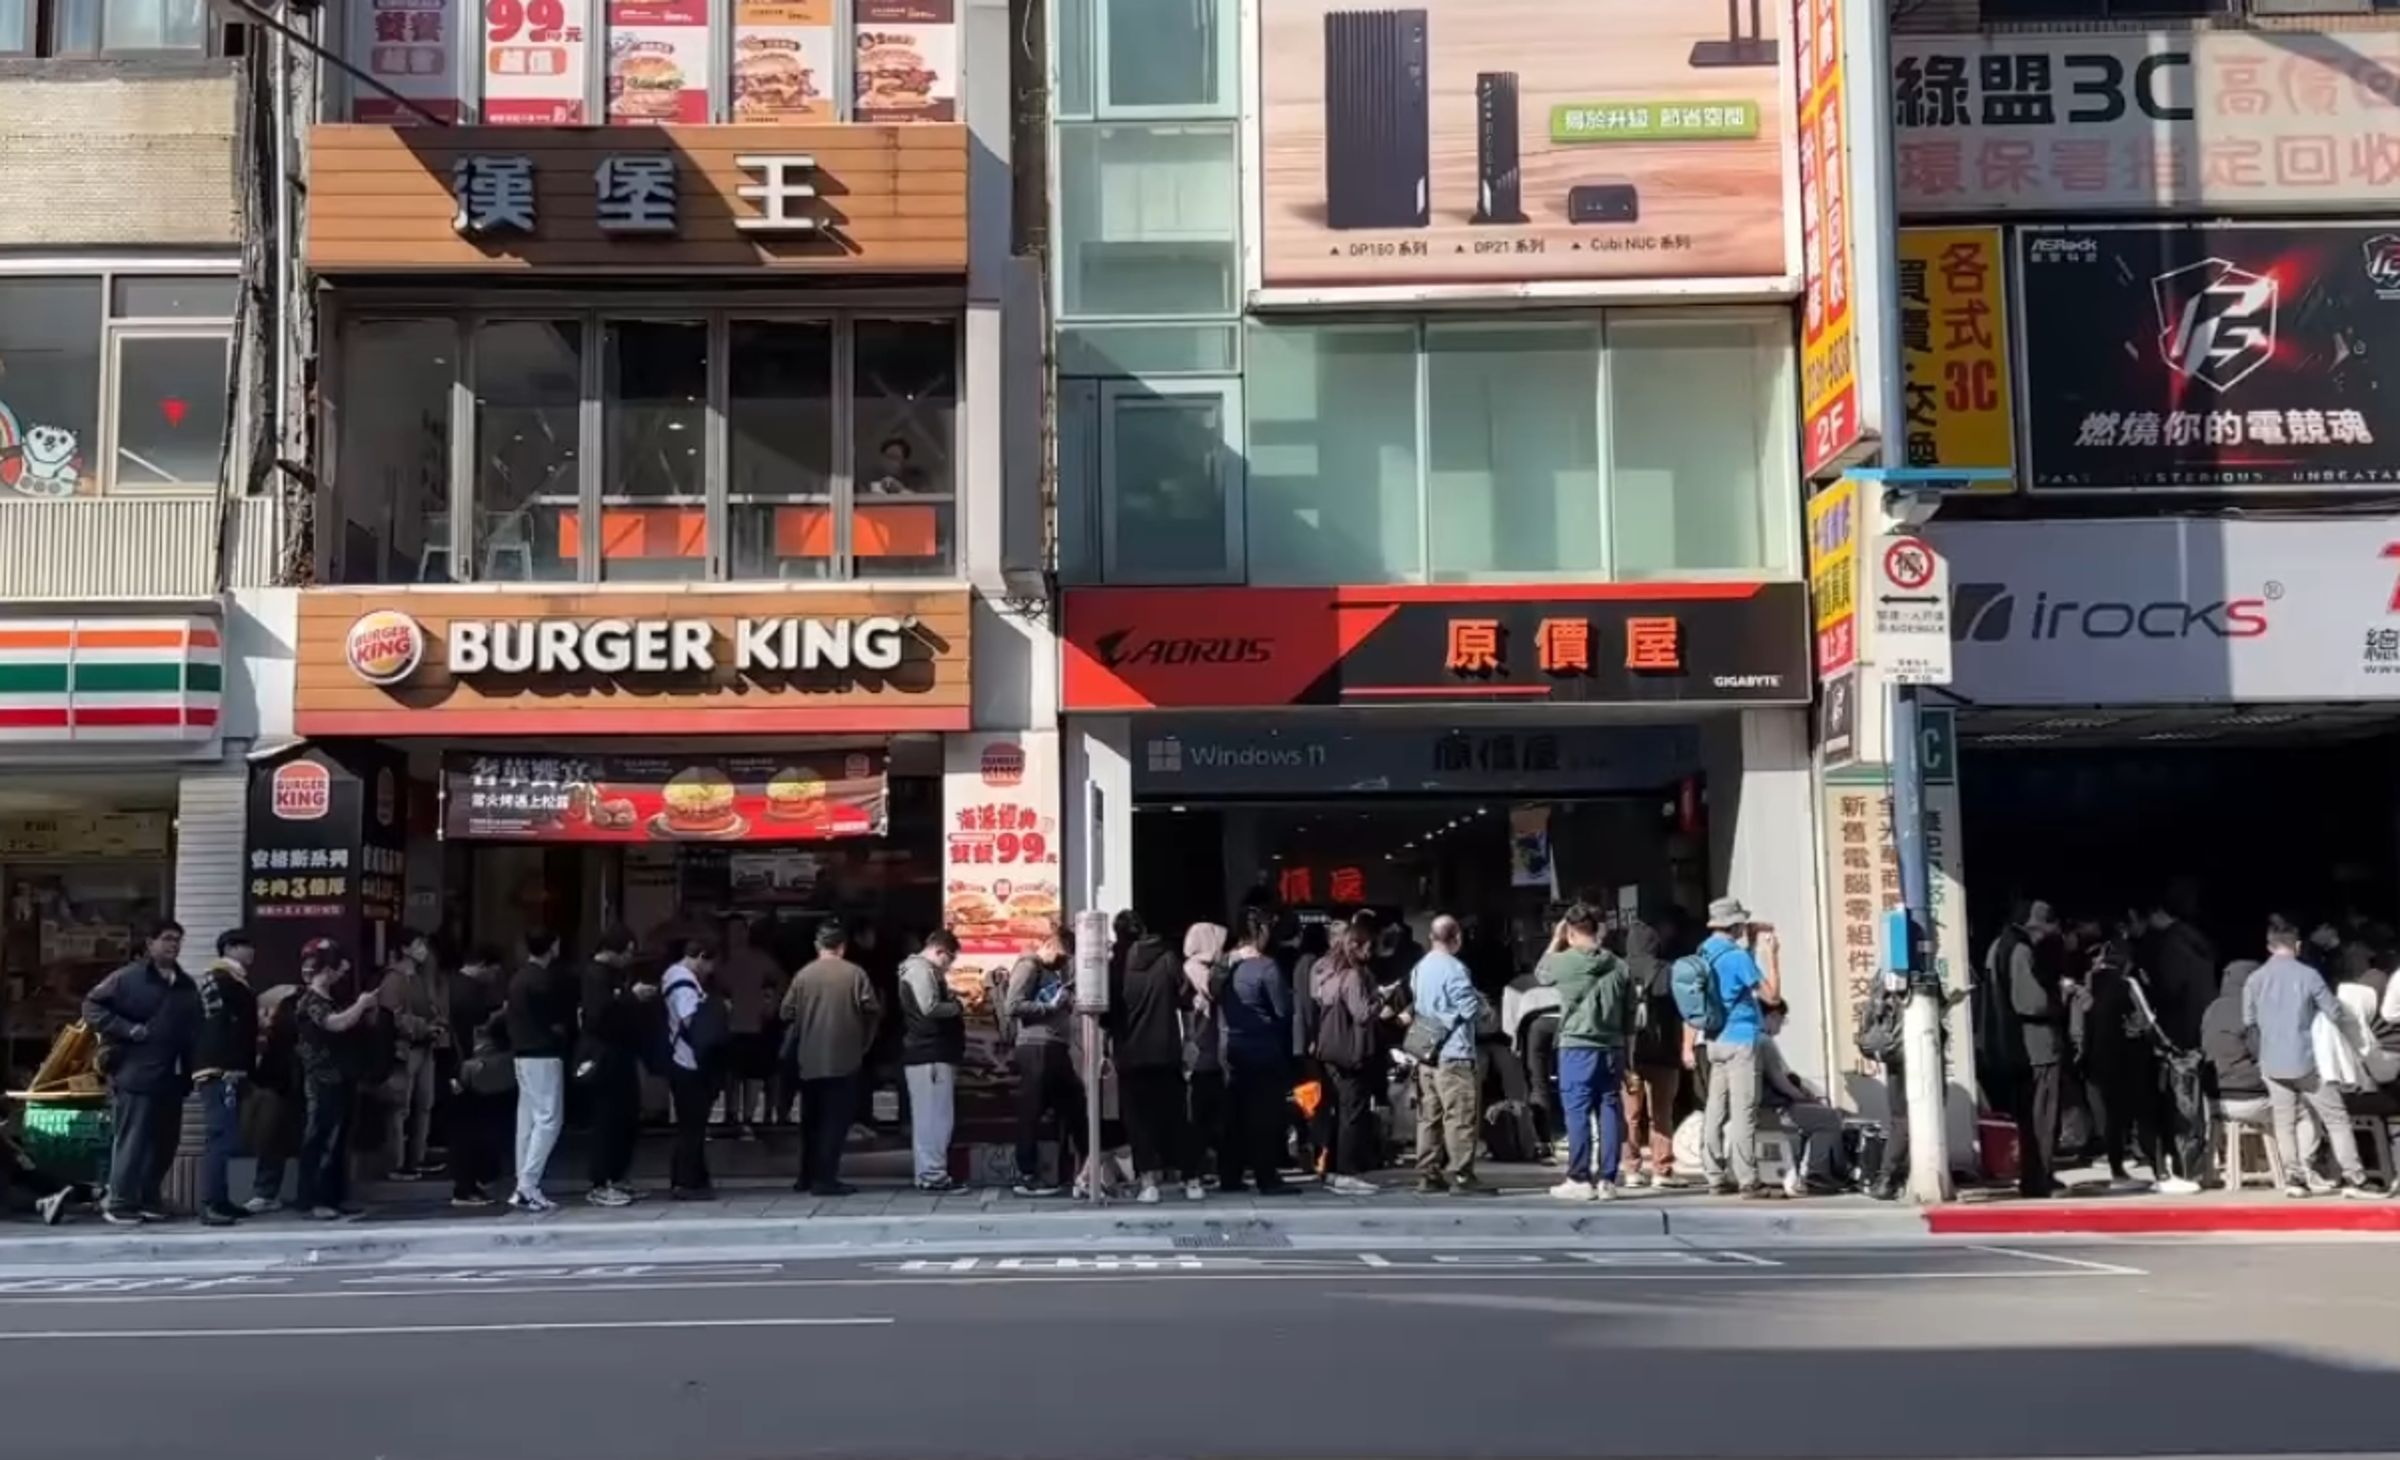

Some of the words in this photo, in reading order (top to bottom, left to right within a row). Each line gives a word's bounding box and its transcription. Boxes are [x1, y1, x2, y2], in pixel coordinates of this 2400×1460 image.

[1894, 53, 2194, 126] 綠盟3C
[1899, 136, 2400, 194] 環保署指定回收
[451, 154, 822, 235] 漢堡王
[1591, 238, 1622, 251] Cubi
[1626, 237, 1656, 250] NUC
[1816, 400, 1845, 458] 2F
[2073, 409, 2374, 447] 燃燒你的電競魂
[2030, 591, 2268, 640] irocks
[357, 639, 410, 663] KING
[447, 619, 714, 674] BURGER
[735, 617, 903, 671] KING
[1129, 637, 1275, 664] AORUS
[1446, 617, 1680, 670] 原價屋
[1190, 744, 1301, 767] Windows
[276, 779, 326, 789] BURGER
[276, 791, 326, 806] KING
[252, 877, 346, 898] 牛肉3倍厚
